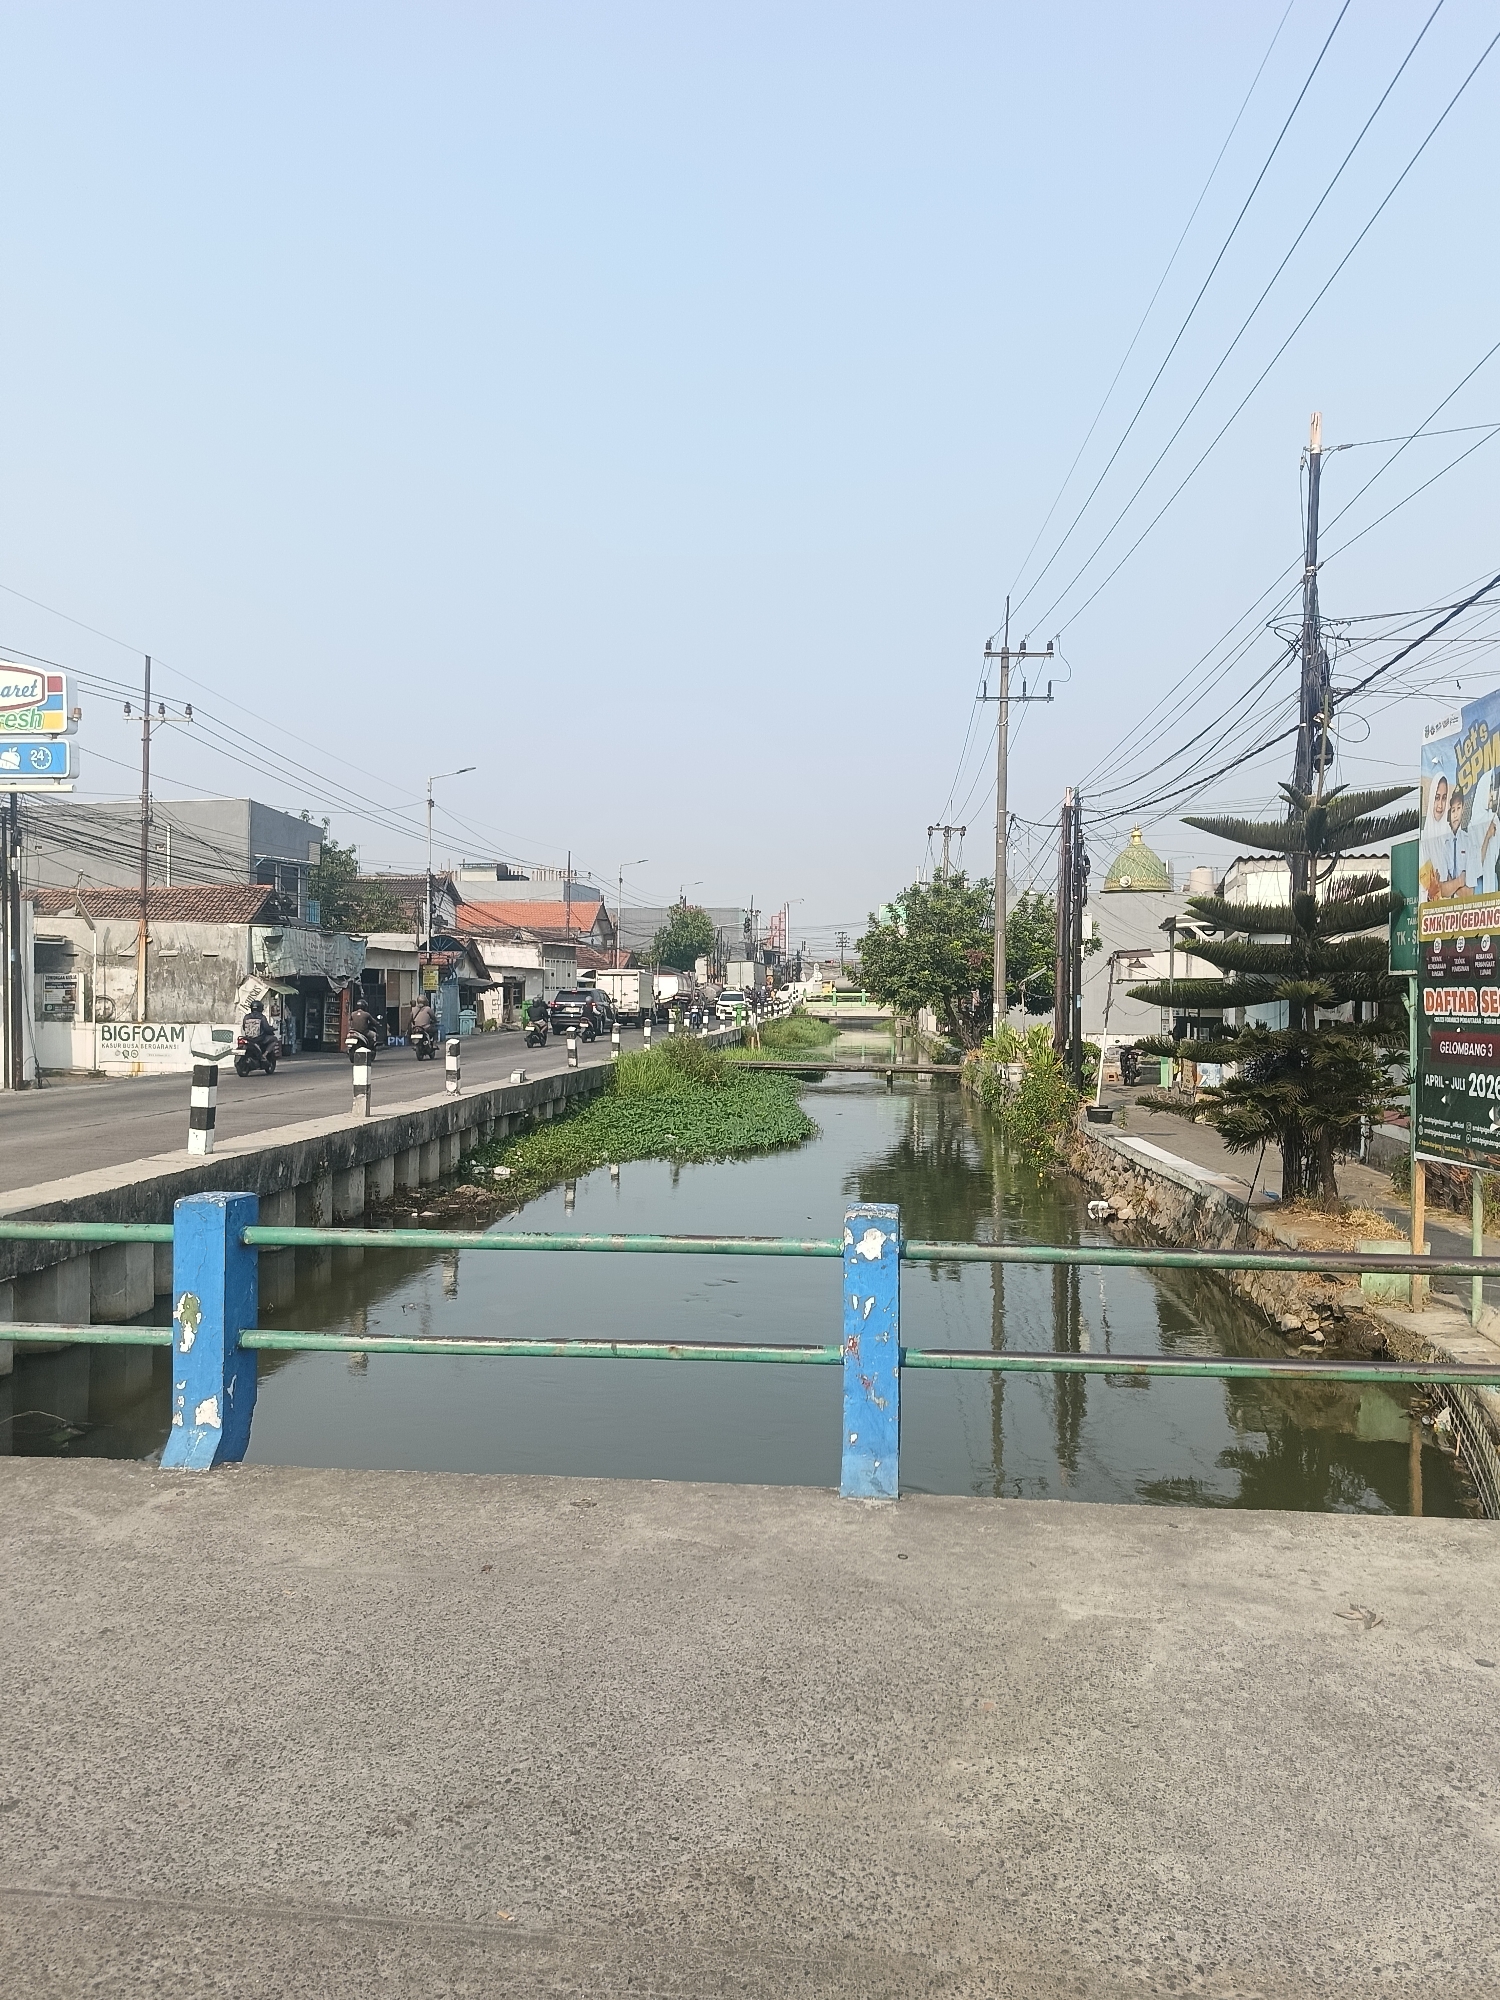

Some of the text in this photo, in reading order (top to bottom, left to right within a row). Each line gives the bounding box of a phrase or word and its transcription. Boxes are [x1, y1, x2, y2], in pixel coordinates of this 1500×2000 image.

[1456, 722, 1488, 766] Let's
[31, 749, 44, 761] 24
[1422, 915, 1442, 933] SMK
[1445, 913, 1459, 932] TPI
[1397, 931, 1406, 946] TK
[1425, 989, 1500, 1014] DAFTAR SE
[101, 1025, 184, 1042] BIGFOAM
[1440, 1041, 1493, 1057] GELOMBANG 3
[1425, 1074, 1444, 1088] APRIL
[1451, 1076, 1465, 1090] JULI
[1468, 1072, 1500, 1100] 2026
